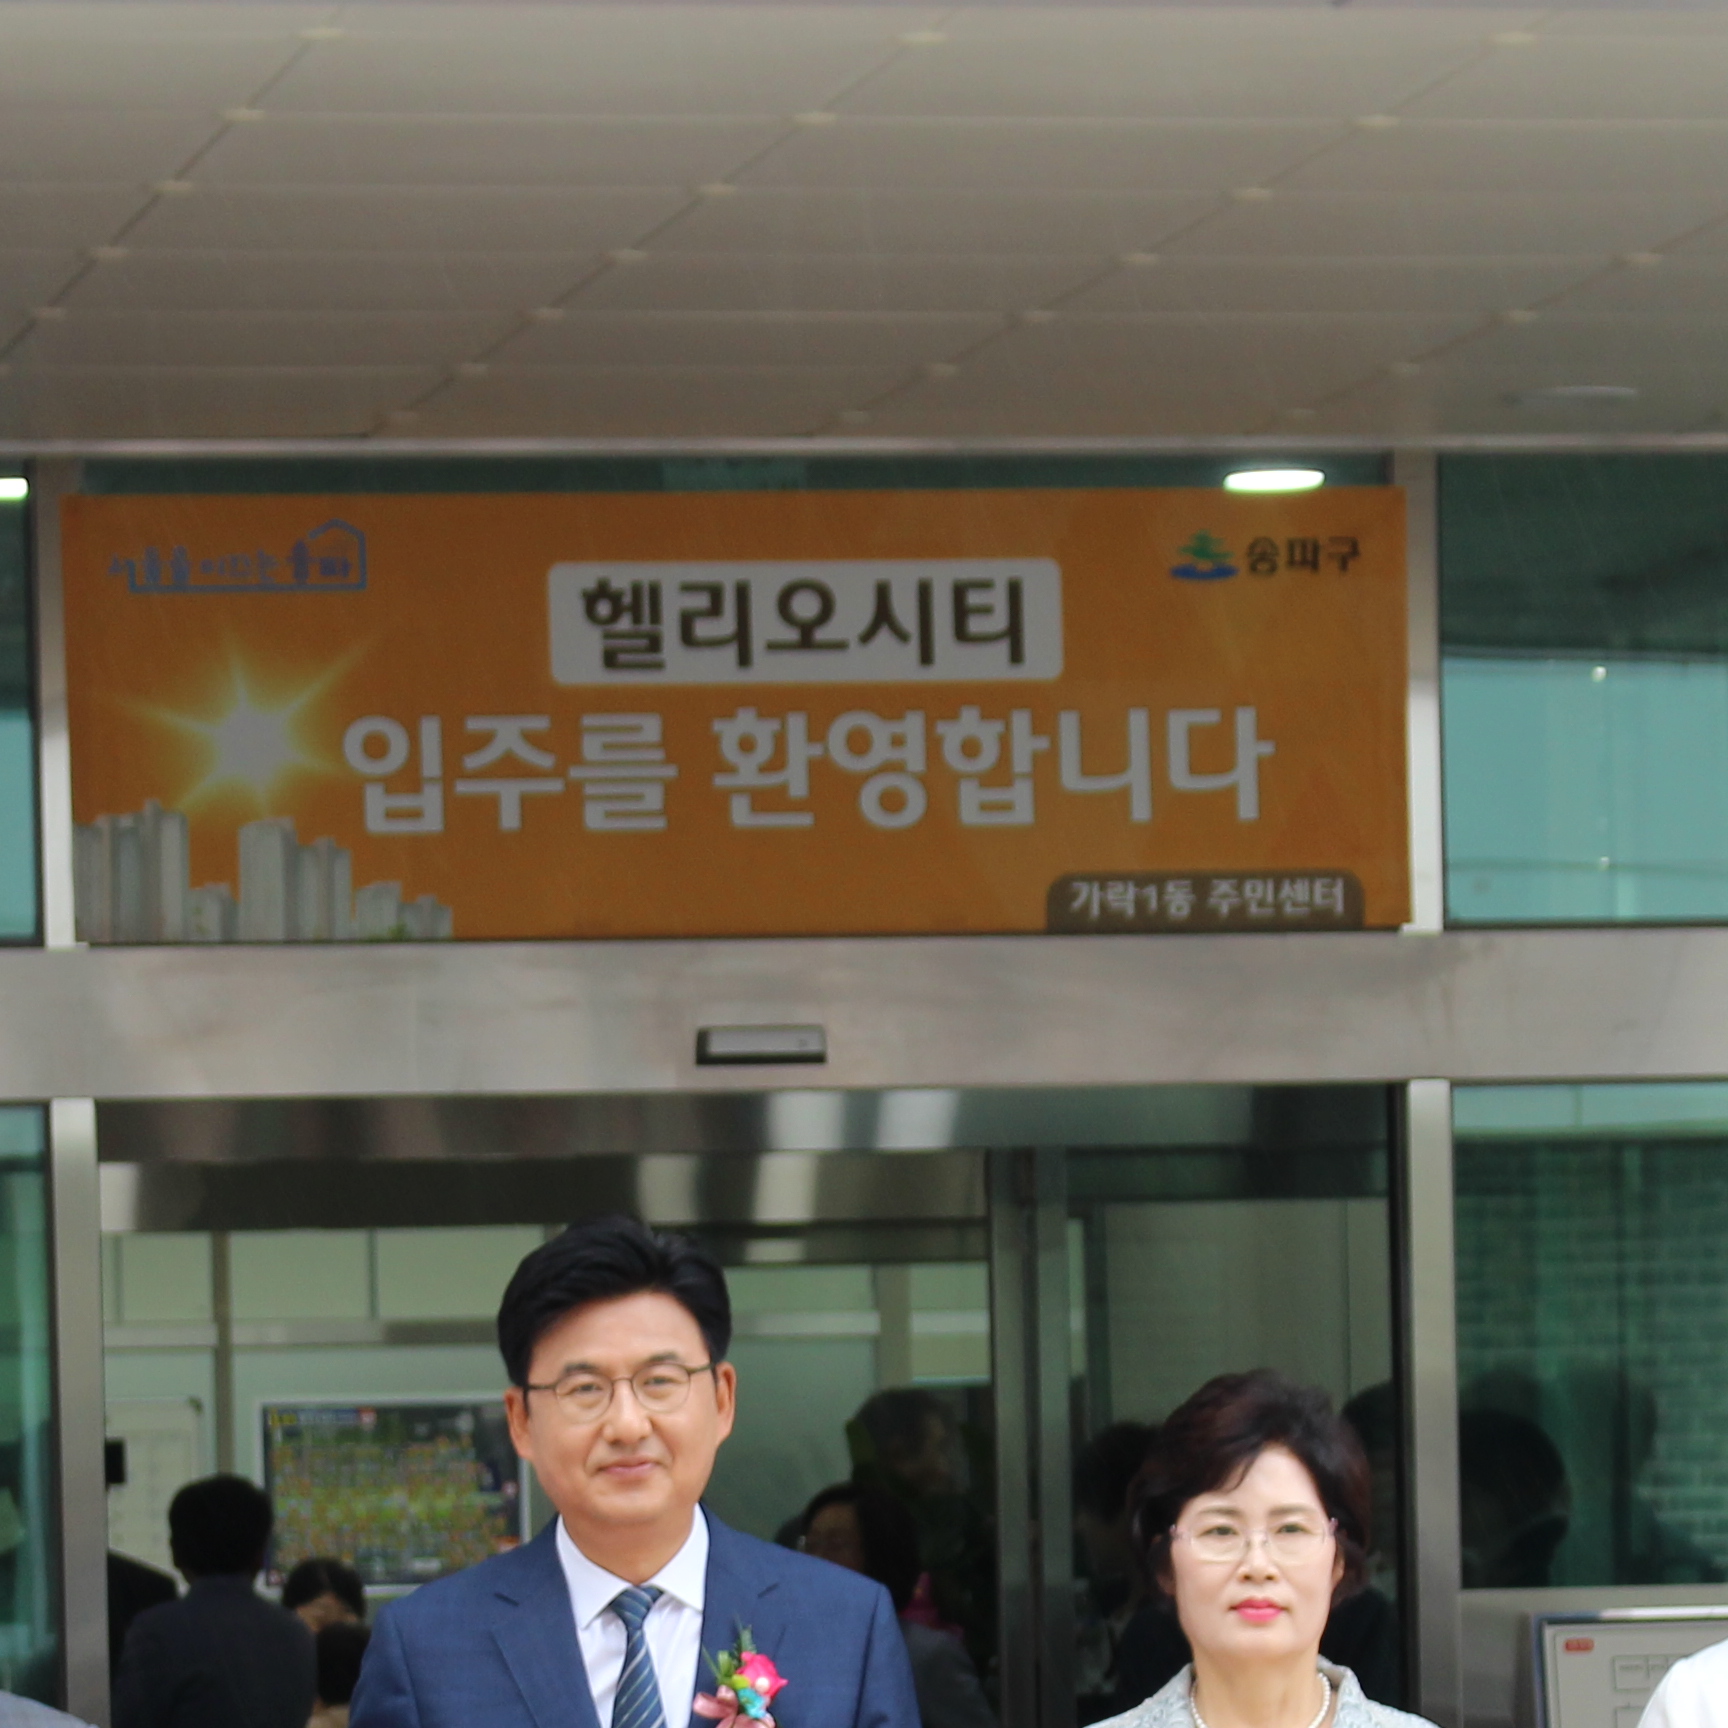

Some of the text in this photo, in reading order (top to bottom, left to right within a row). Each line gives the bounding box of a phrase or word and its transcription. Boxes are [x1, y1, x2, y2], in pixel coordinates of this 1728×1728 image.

[1247, 536, 1360, 576] 송파구
[581, 576, 1025, 670] 헬리오시티
[342, 705, 1276, 834] 입주를 환영합니다
[1070, 877, 1345, 921] 가락1동 주민센터
